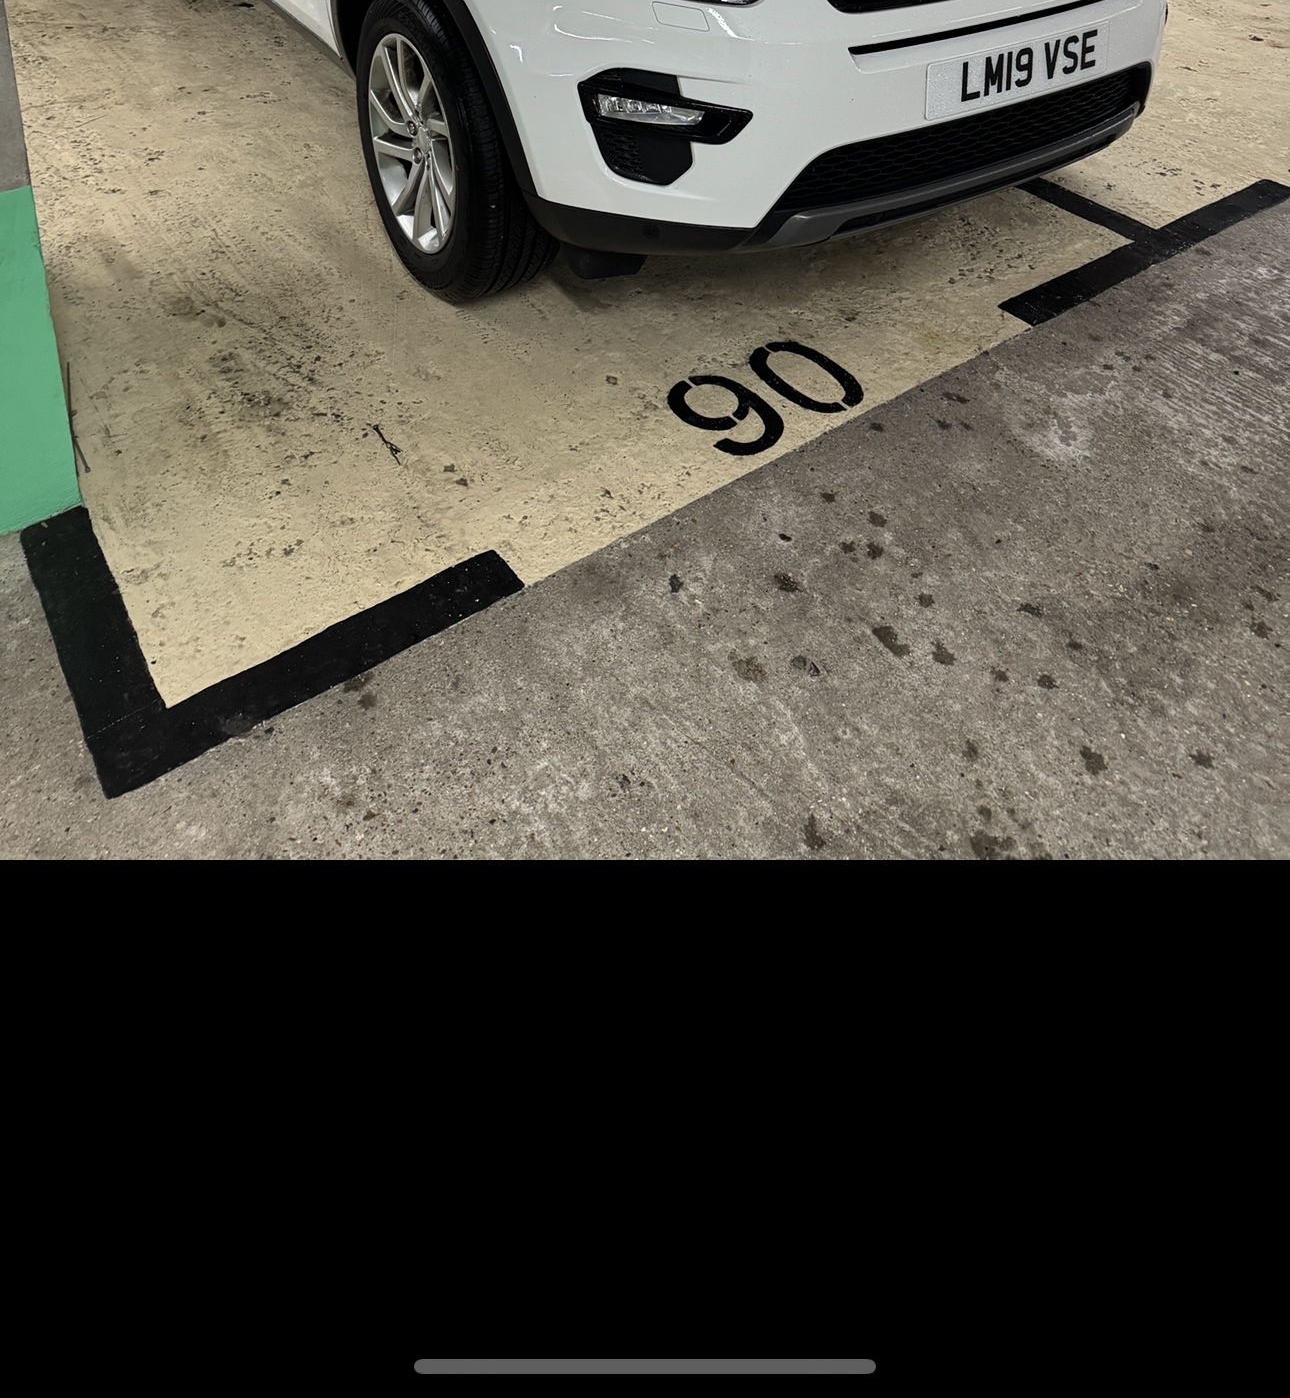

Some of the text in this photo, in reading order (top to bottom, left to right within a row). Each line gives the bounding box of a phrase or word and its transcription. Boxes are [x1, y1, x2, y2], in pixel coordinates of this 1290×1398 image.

[961, 29, 1098, 102] LM19 VSE
[667, 341, 864, 456] 90
